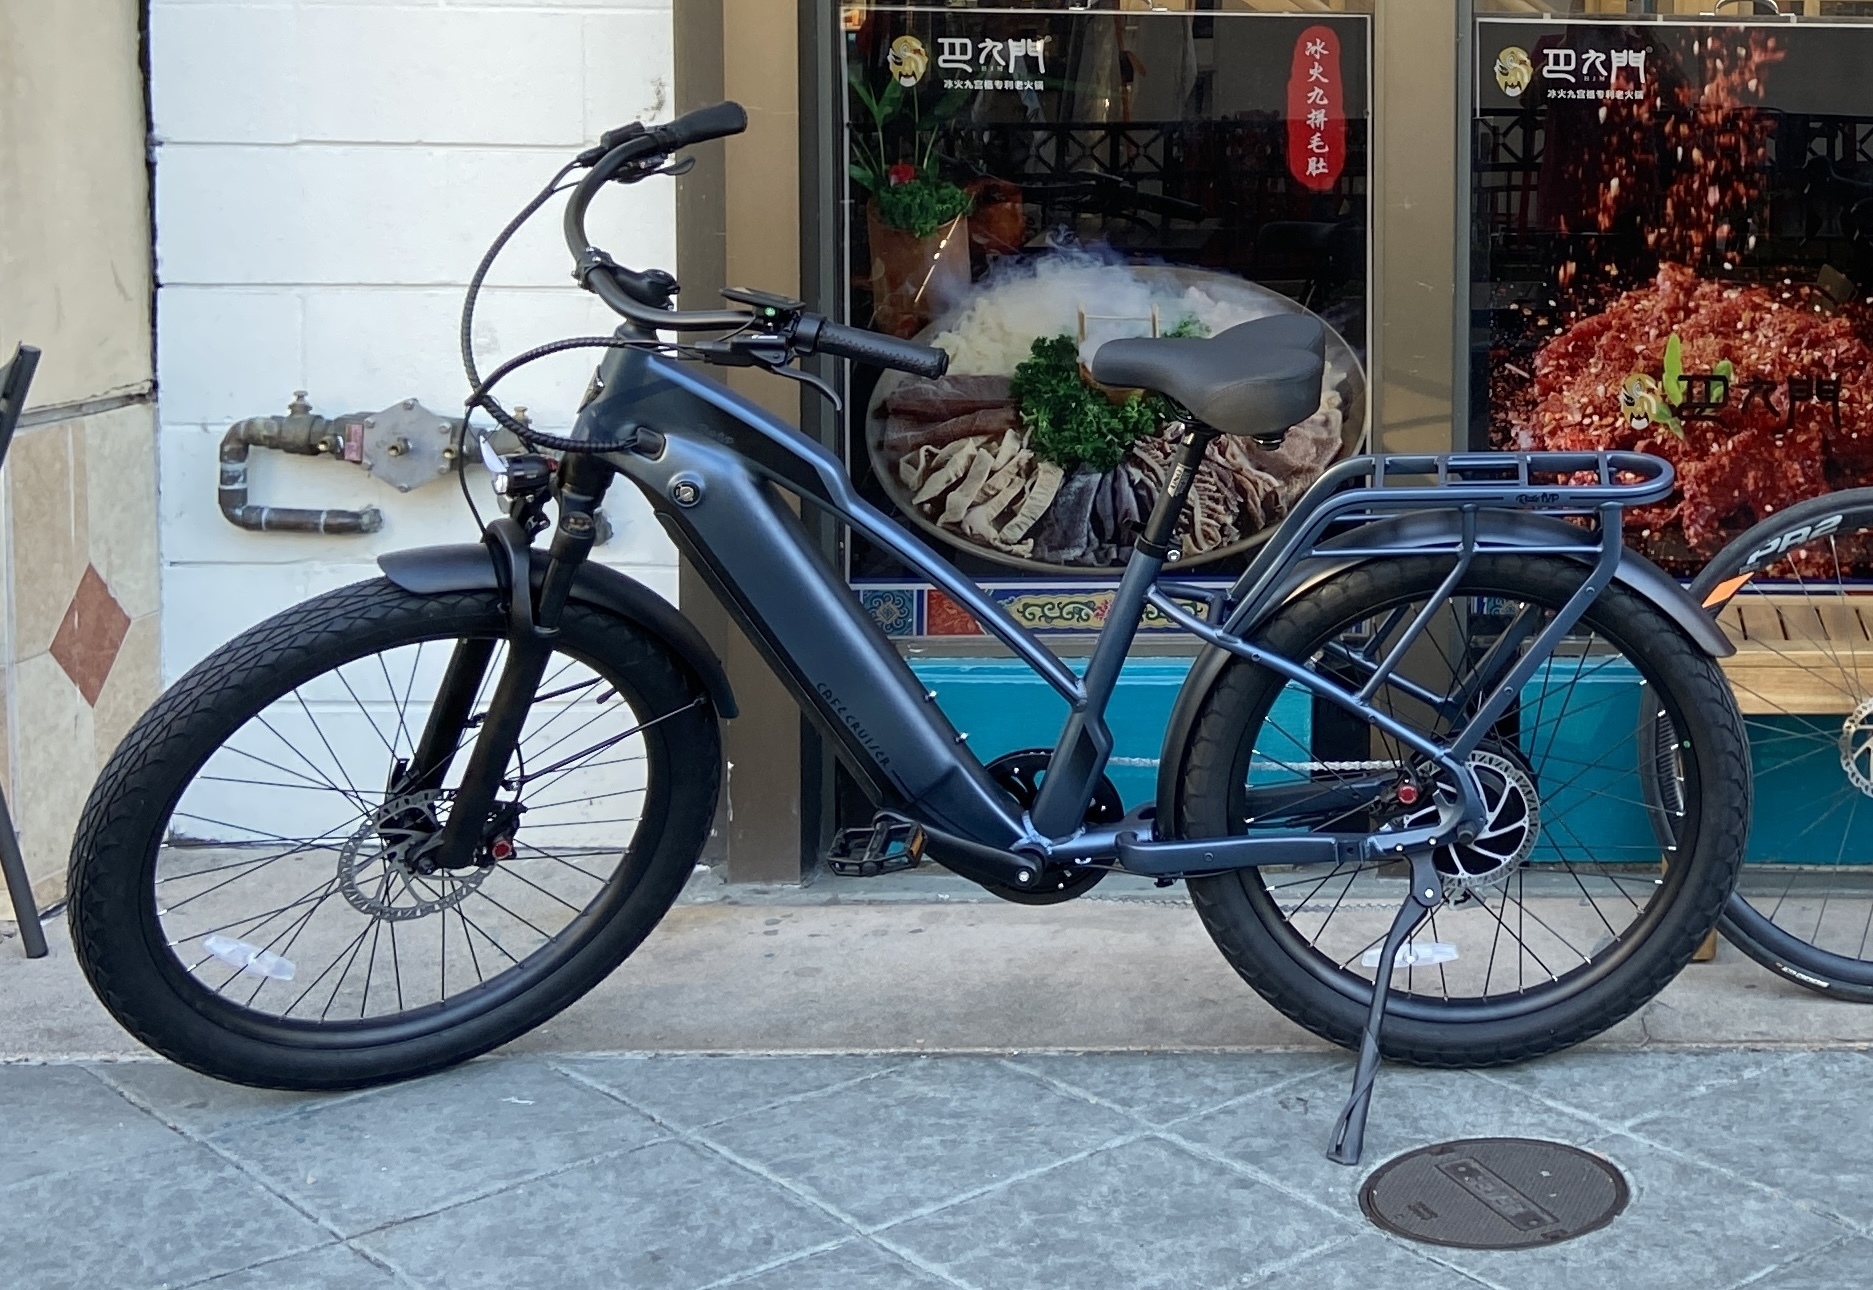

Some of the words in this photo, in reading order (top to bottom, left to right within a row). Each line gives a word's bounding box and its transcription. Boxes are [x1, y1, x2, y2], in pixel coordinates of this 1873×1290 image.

[1304, 38, 1330, 177] 冰火九拼毛肚
